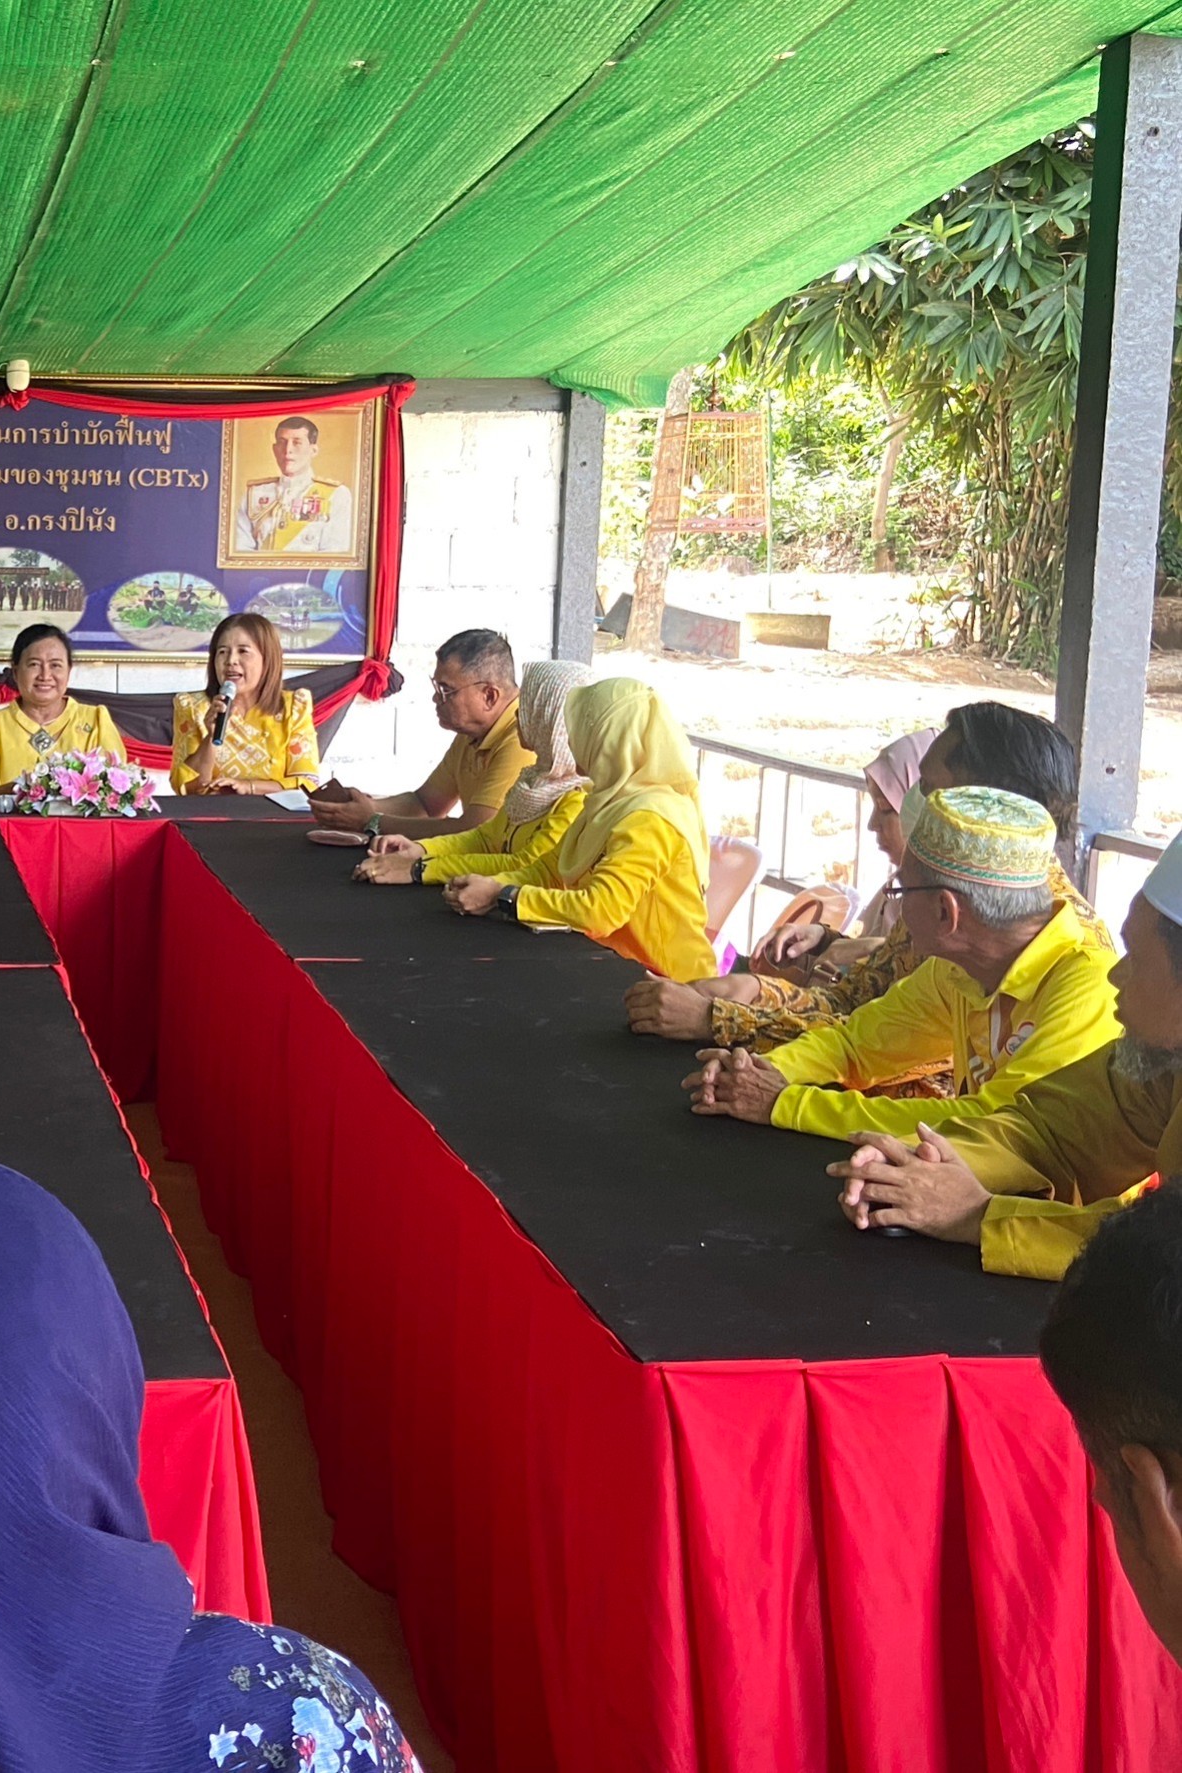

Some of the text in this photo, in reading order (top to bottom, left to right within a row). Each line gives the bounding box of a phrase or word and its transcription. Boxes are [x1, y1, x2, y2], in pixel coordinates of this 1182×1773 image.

[128, 467, 209, 491] (CBTx)
[6, 507, 116, 532] อ.กรงปินัง
